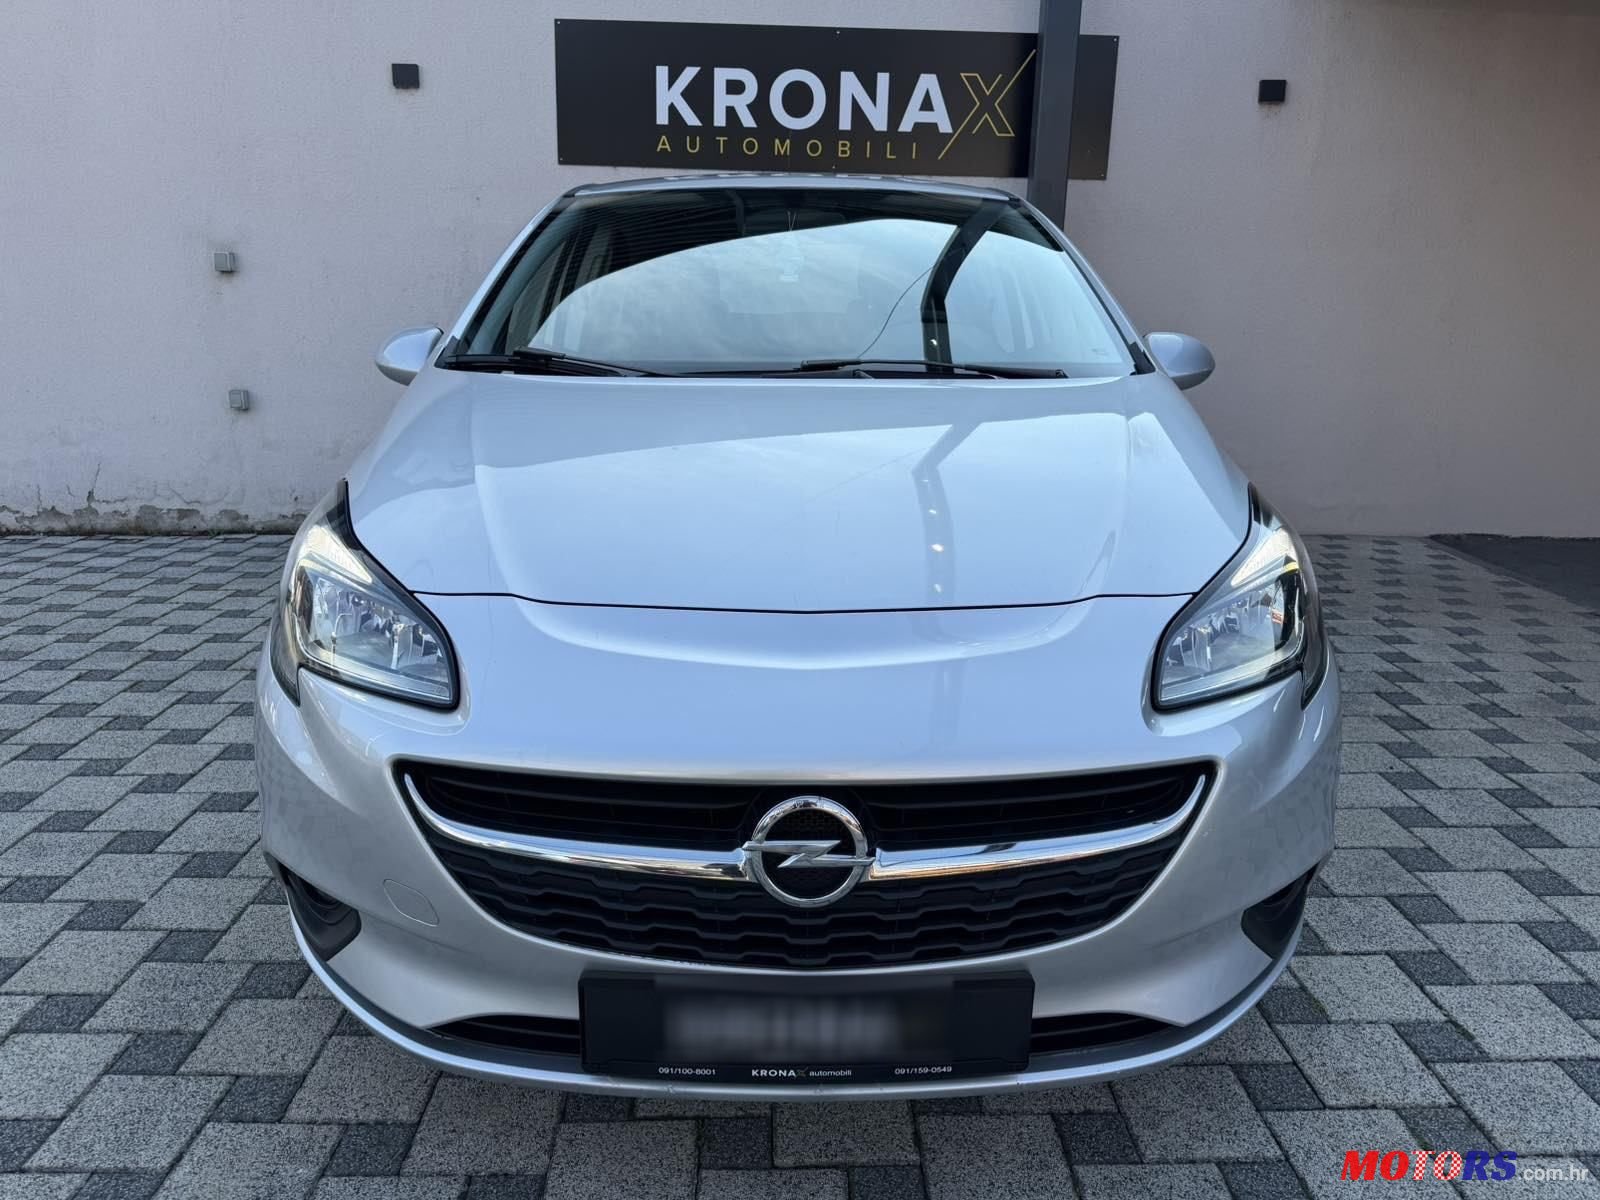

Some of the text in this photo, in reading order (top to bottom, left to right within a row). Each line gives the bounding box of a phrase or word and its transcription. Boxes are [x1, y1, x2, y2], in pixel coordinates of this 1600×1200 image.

[655, 50, 1036, 159] KRONAX
[656, 135, 918, 159] AUTOMOBILI
[658, 1066, 717, 1076] 091/100-8001
[809, 1069, 852, 1077] automobili
[894, 1065, 953, 1075] 091/159-0549
